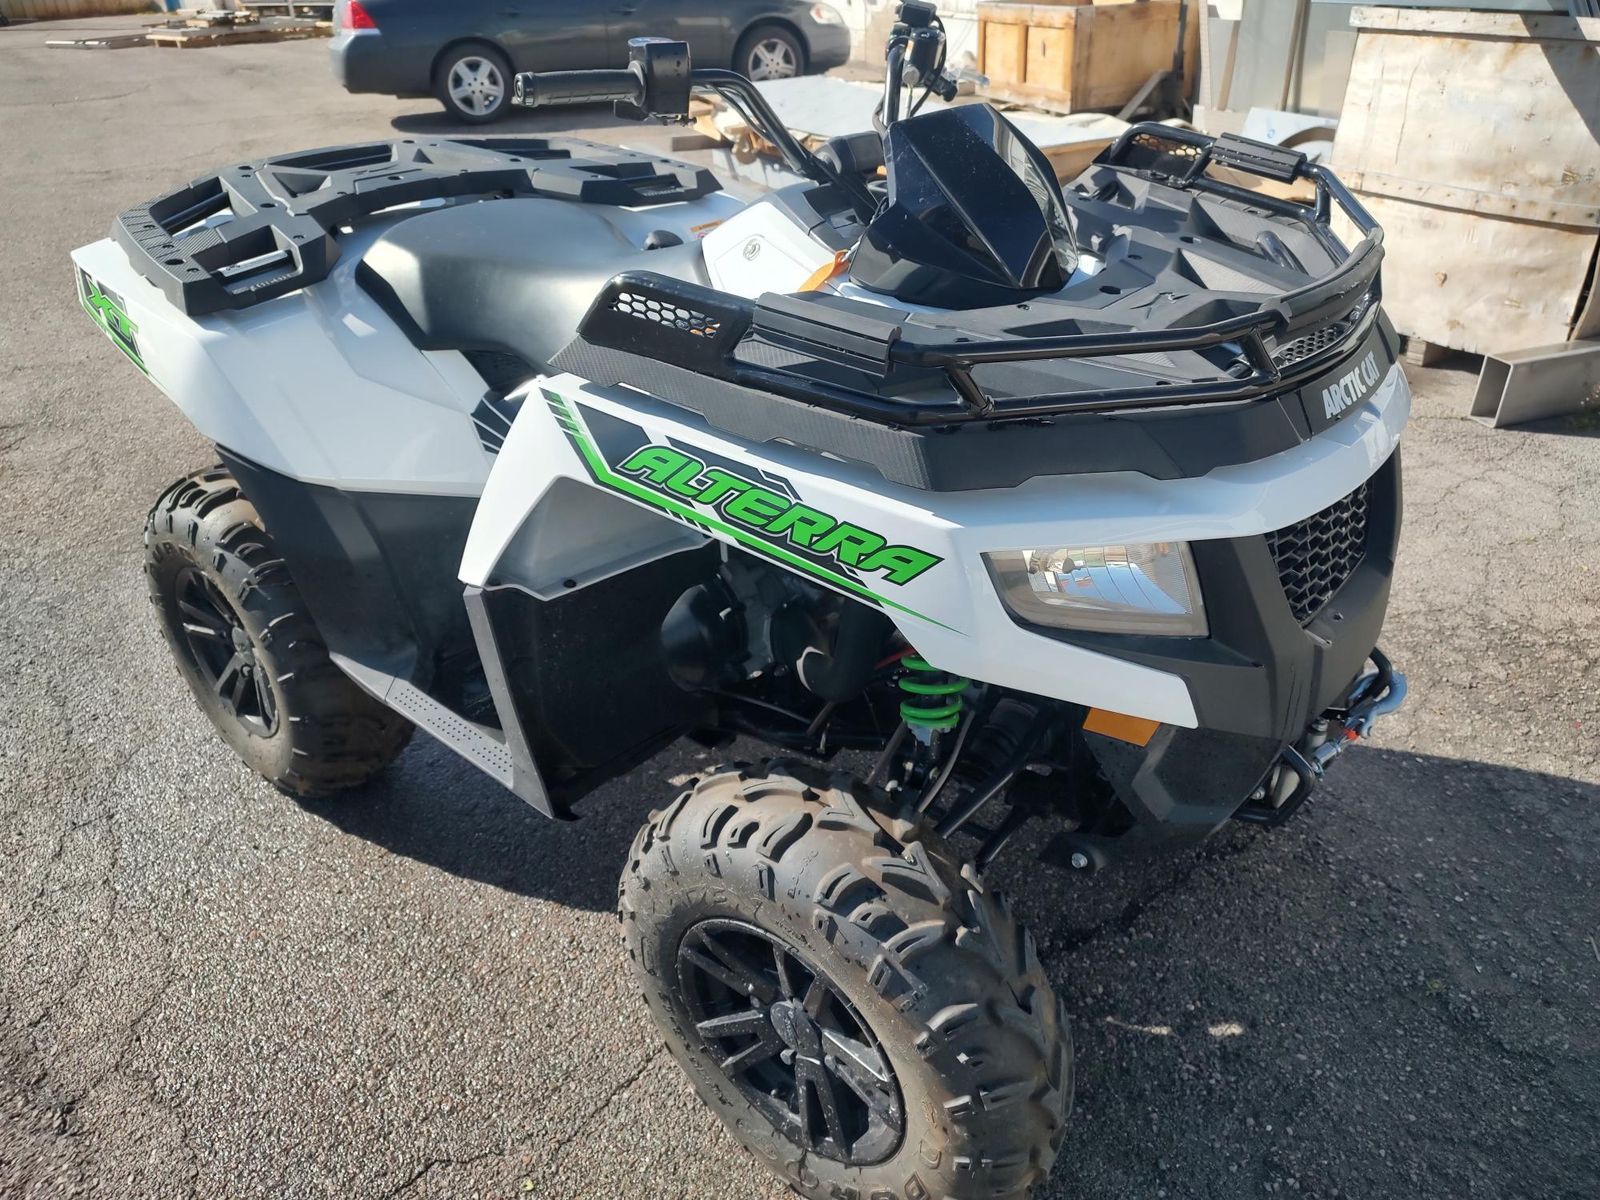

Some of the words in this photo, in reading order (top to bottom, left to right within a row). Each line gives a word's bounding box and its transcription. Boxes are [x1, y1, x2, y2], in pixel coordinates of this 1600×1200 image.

[86, 276, 139, 340] XT
[1322, 366, 1367, 419] ARCTIC
[1361, 351, 1380, 387] CAT
[617, 446, 944, 586] ALTERRA
